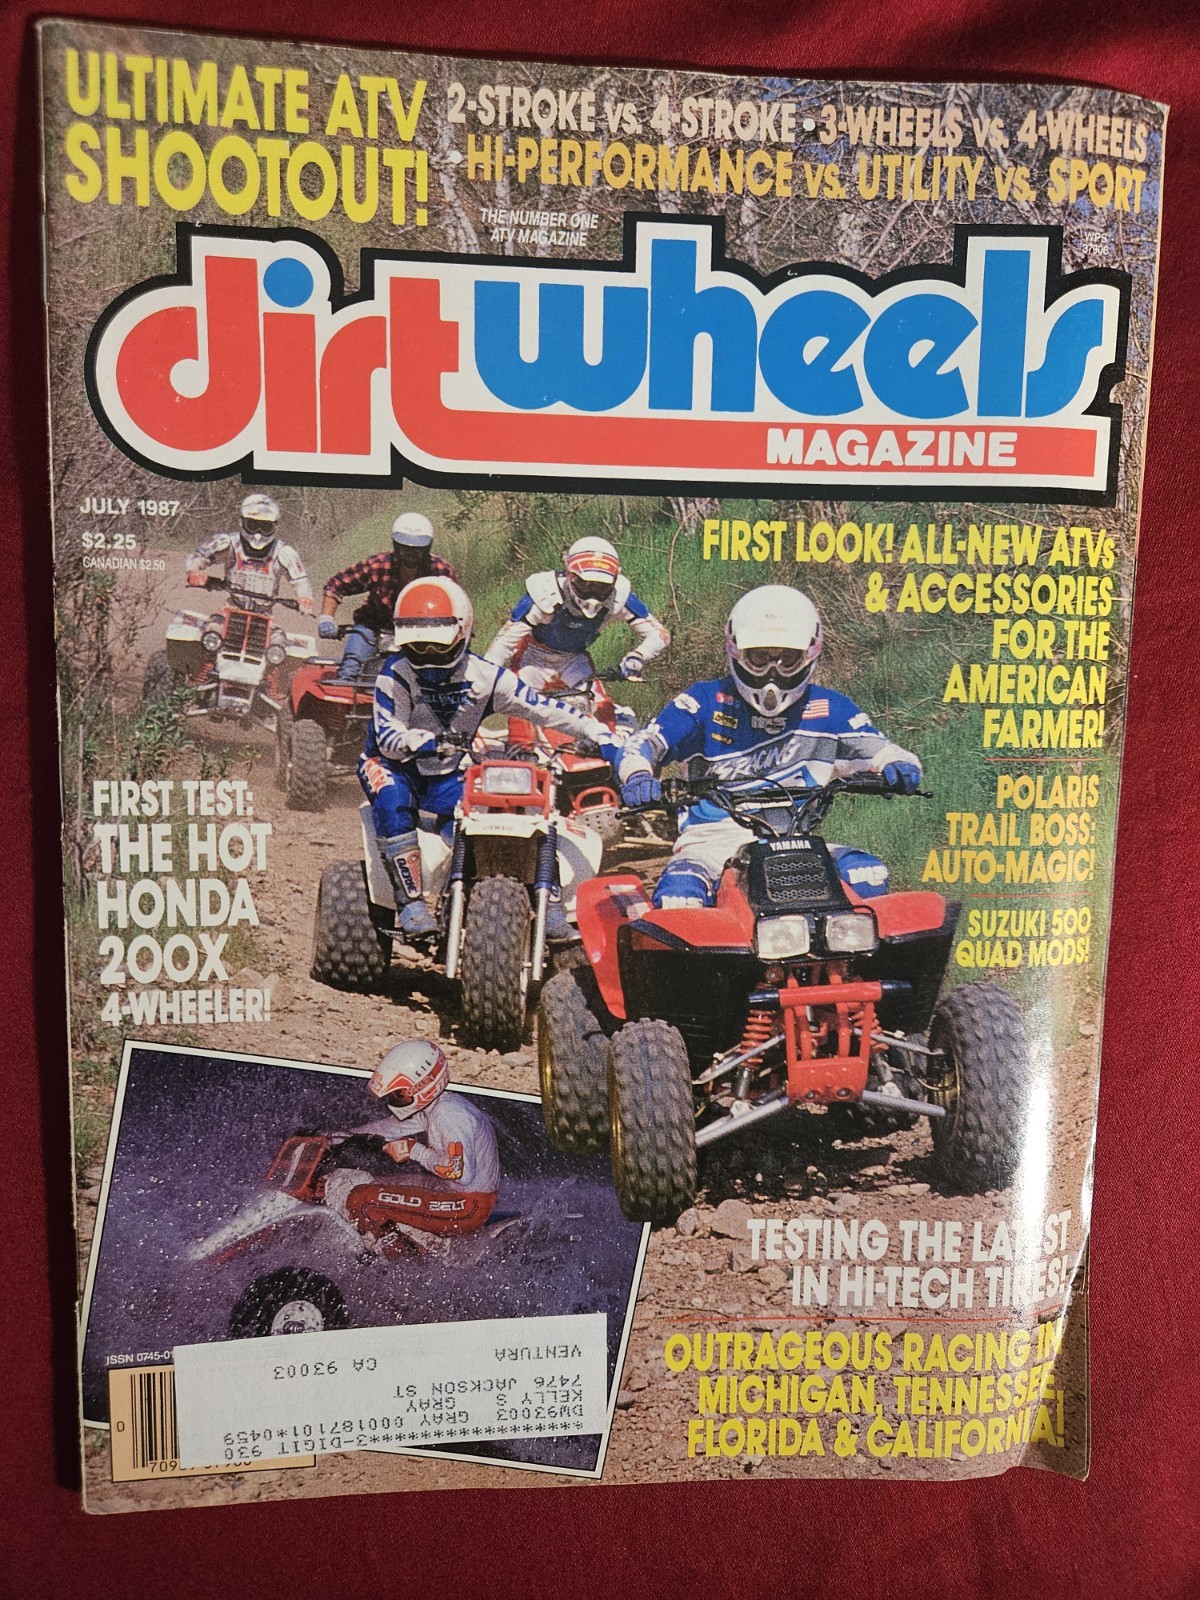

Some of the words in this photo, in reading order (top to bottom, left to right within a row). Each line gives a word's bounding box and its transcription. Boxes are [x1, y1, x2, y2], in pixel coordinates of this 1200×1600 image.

[66, 48, 309, 134] ULTIMATE
[325, 74, 427, 142] ATV
[447, 82, 596, 132] 2-STROKE
[651, 97, 796, 143] 4-STROKE
[819, 104, 963, 149] 3-WHEELS
[1018, 110, 1148, 163] 4-WHEELS
[66, 121, 428, 227] SHOOTOUT!
[467, 134, 793, 198] HI-PERFORMANCE
[858, 154, 984, 201] UTILITY
[1048, 156, 1147, 214] SPORT
[480, 207, 507, 224] THE
[510, 209, 567, 227] NUMBER
[570, 212, 599, 229] ONE
[490, 227, 516, 242] ATV
[518, 228, 588, 247] MAGAZINE
[1084, 231, 1108, 243] WPS
[766, 427, 1018, 467] MAGAZINE
[80, 497, 130, 515] JULY
[137, 499, 180, 517] 1987
[81, 531, 137, 550] $2.25
[703, 518, 787, 562] FIRST
[796, 520, 894, 564] LOOK!
[900, 523, 1043, 566] ALL-NEW
[1048, 527, 1115, 570] ATVs
[83, 556, 137, 570] CANADIAN
[139, 559, 165, 571] $2.50
[864, 571, 888, 613] &
[897, 572, 1113, 617] ACCESSORIES
[993, 618, 1054, 660] FOR
[1064, 620, 1110, 661] THE
[942, 664, 1107, 705] AMERICAN
[983, 709, 1103, 749] FARMER!
[93, 780, 173, 816] FIRST
[183, 780, 253, 816] TEST:
[996, 774, 1100, 810] POLARIS
[946, 812, 1021, 846] TRAIL
[1030, 811, 1096, 847] BOSS:
[93, 823, 173, 873] THE
[188, 822, 272, 872] HOT
[769, 840, 812, 851] YAMAHA
[921, 848, 1095, 884] AUTO-MAGIC!
[97, 879, 259, 929] HONDA
[968, 909, 1046, 938] SUZUKI
[1052, 906, 1092, 936] 500
[99, 933, 229, 985] 200X
[956, 939, 1022, 968] QUAD
[1028, 936, 1090, 967] MODS!
[101, 988, 271, 1027] 4-WHEELER!
[377, 1192, 422, 1208] GOLD
[428, 1199, 467, 1211] BELT
[747, 1218, 889, 1261] TESTING
[900, 1220, 962, 1262] THE
[792, 1265, 829, 1307] IN
[839, 1265, 975, 1309] HI-TECH
[105, 1353, 134, 1365] ISSN
[494, 1344, 582, 1361] VENTURA
[664, 1331, 893, 1373] OUTRAGEOUS
[903, 1329, 1031, 1372] RACING
[1037, 1317, 1063, 1361] IN
[273, 1361, 338, 1380] 93003
[353, 1357, 377, 1372] CA
[393, 1385, 417, 1398] ST
[431, 1378, 517, 1396] JACKSON
[521, 1389, 582, 1405] KELLY
[533, 1373, 582, 1389] 7476
[698, 1374, 882, 1420] MICHIGAN,
[406, 1396, 456, 1413] GRAY
[496, 1393, 507, 1407] S
[496, 1404, 583, 1421] DW93003
[116, 1420, 125, 1432] 0
[420, 1410, 469, 1426] GRAY
[687, 1417, 825, 1458] FLORIDA
[833, 1417, 858, 1457] &
[866, 1403, 1065, 1458] CALIFORNIA!
[224, 1444, 262, 1460] 930
